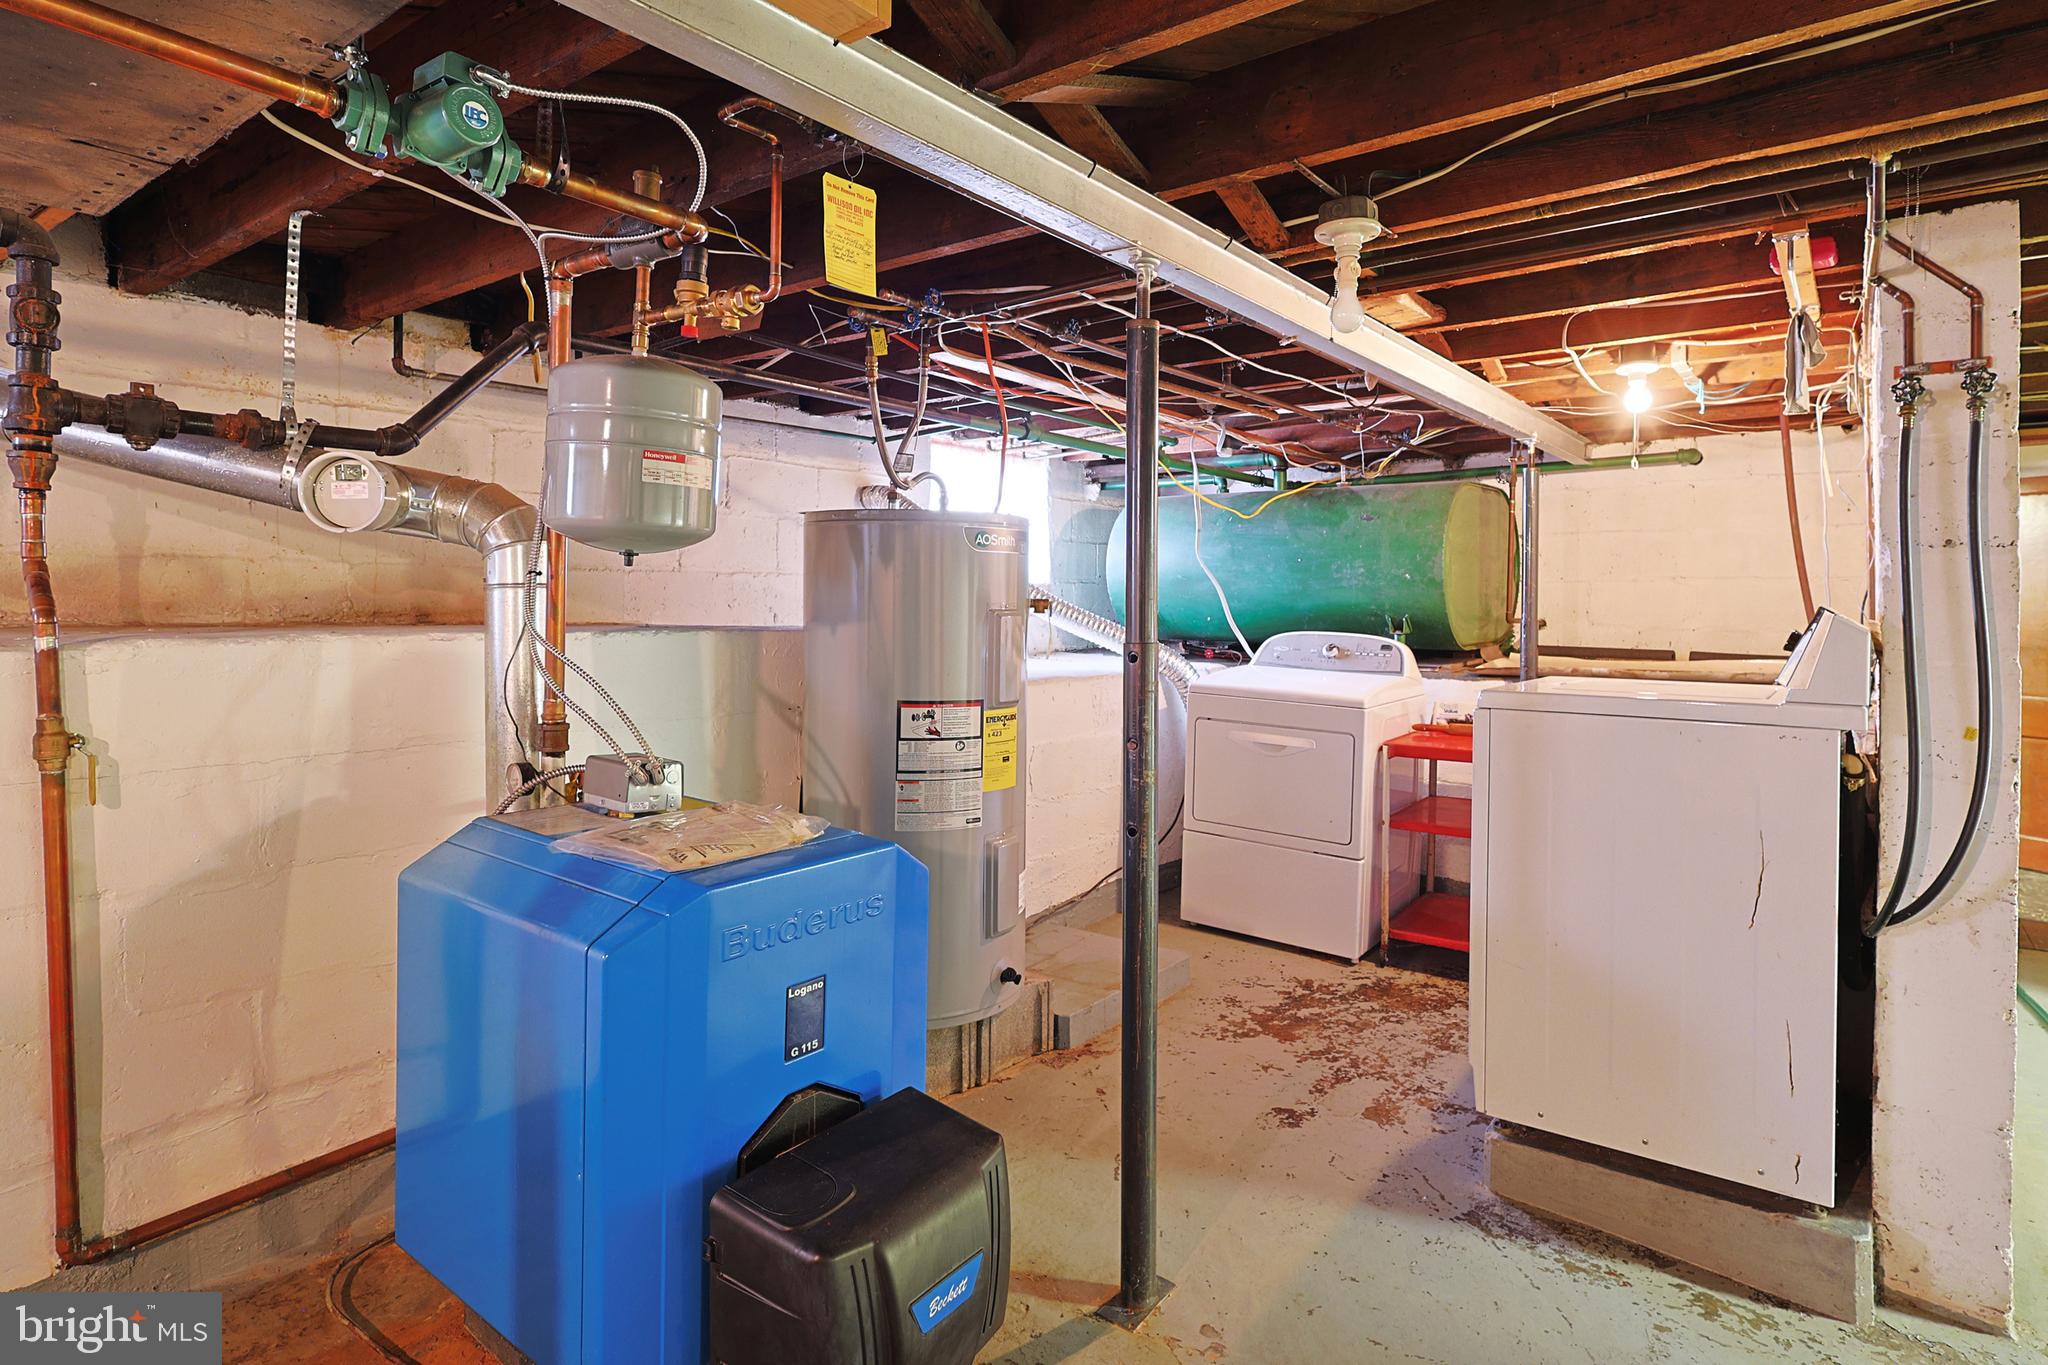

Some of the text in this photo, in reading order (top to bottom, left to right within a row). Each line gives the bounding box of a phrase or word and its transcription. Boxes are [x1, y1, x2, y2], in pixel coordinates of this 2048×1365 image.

[827, 194, 853, 211] WILLISON
[853, 205, 863, 215] OIL
[644, 451, 677, 461] Honeywell
[975, 534, 1016, 546] AOSmith
[720, 893, 885, 963] Buderus
[788, 980, 824, 998] Logano
[791, 1039, 819, 1058] G 115
[929, 1276, 968, 1318] Beckett
